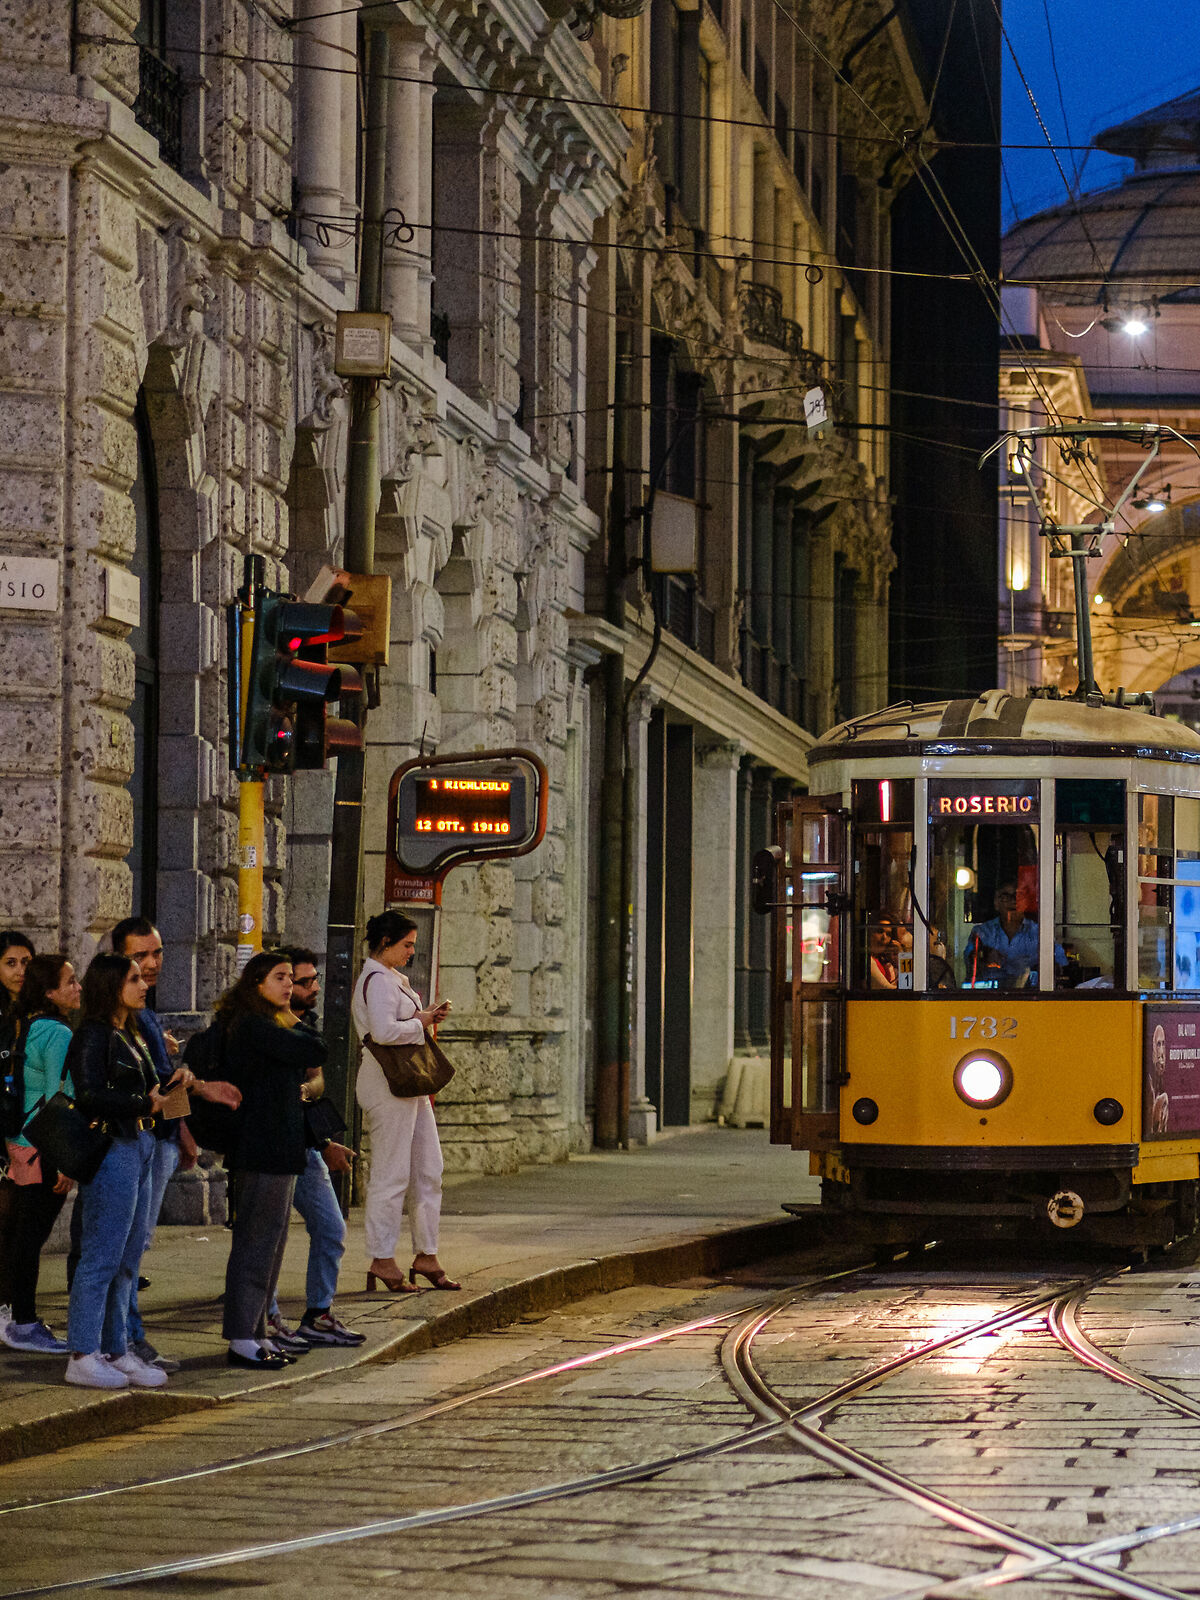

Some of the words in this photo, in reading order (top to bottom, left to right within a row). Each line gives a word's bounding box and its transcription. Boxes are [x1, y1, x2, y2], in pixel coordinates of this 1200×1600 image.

[0, 582, 45, 598] SIO
[940, 796, 1031, 813] ROSERIO
[416, 820, 431, 830] 12
[437, 820, 465, 831] OTT.
[473, 822, 509, 832] 19:10
[950, 1016, 1018, 1039] 1732
